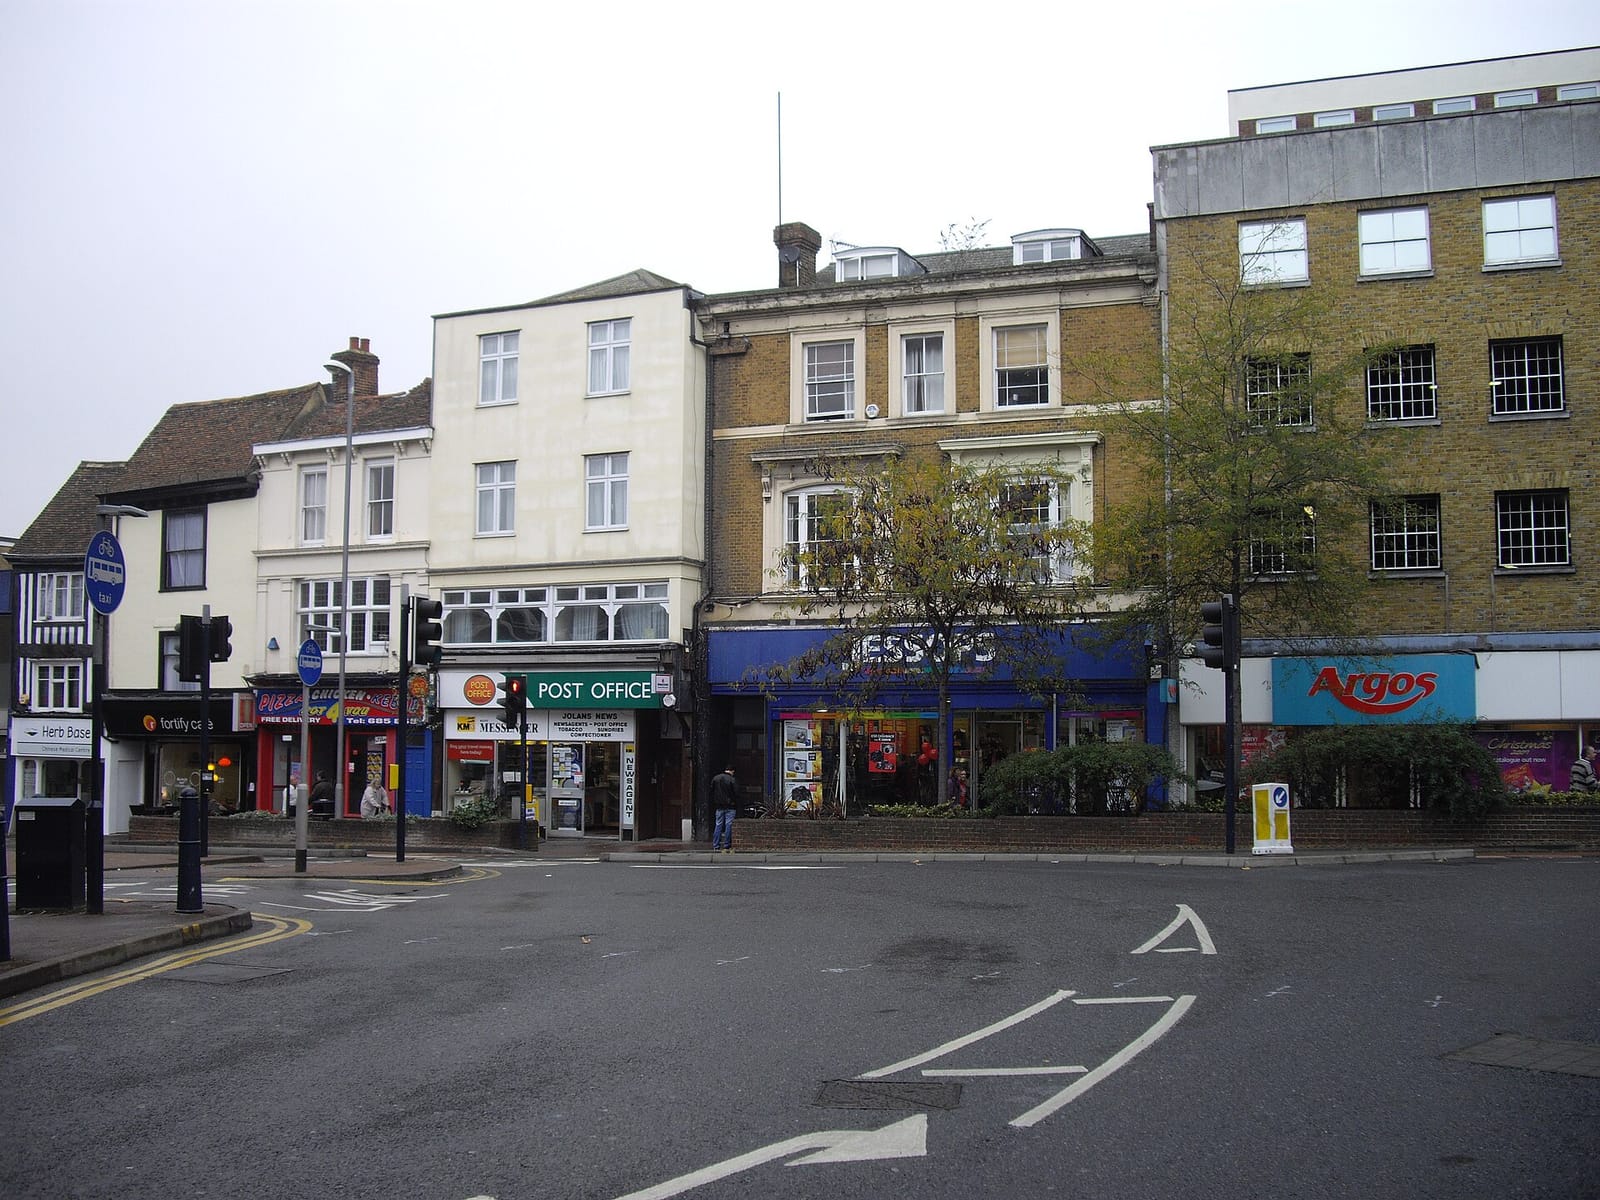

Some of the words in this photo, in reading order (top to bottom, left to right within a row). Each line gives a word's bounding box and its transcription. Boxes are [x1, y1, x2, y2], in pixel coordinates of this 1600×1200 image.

[98, 592, 112, 604] taxi
[467, 690, 492, 698] OFFICE
[539, 682, 584, 699] POST
[591, 682, 651, 699] OFFICE
[1307, 666, 1440, 710] Argos
[344, 706, 370, 716] YOU
[562, 712, 593, 720] JOLANS
[595, 712, 618, 720] NEWS
[160, 717, 189, 732] fortify
[480, 722, 539, 734] MESSENER
[42, 726, 65, 738] Herb
[67, 726, 91, 739] Base
[1487, 737, 1553, 750] Christmas
[624, 758, 635, 818] NEWSAGENT
